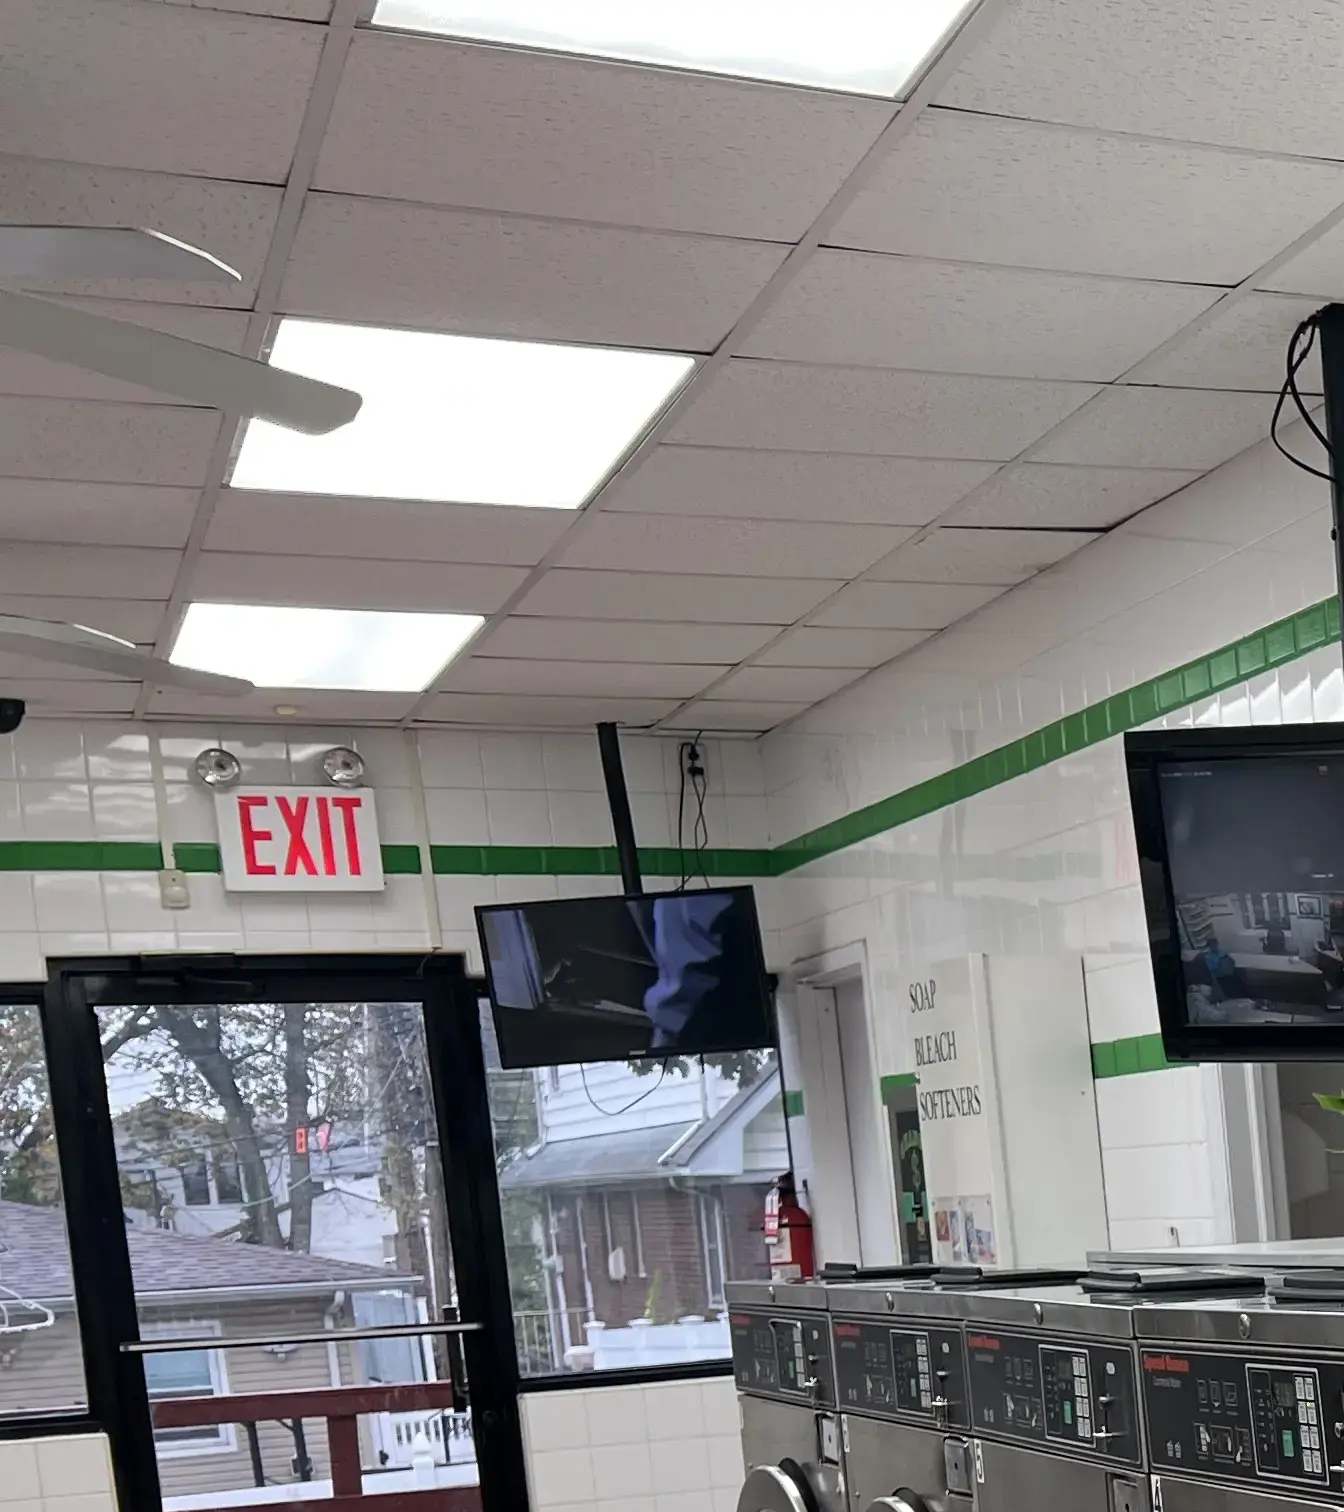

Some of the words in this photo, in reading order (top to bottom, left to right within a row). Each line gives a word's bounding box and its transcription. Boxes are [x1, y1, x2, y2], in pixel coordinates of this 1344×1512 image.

[237, 796, 362, 875] EXIT
[909, 979, 936, 1013] SOAP
[914, 1030, 957, 1066] BLEACH
[919, 1085, 981, 1121] SOFTENERS
